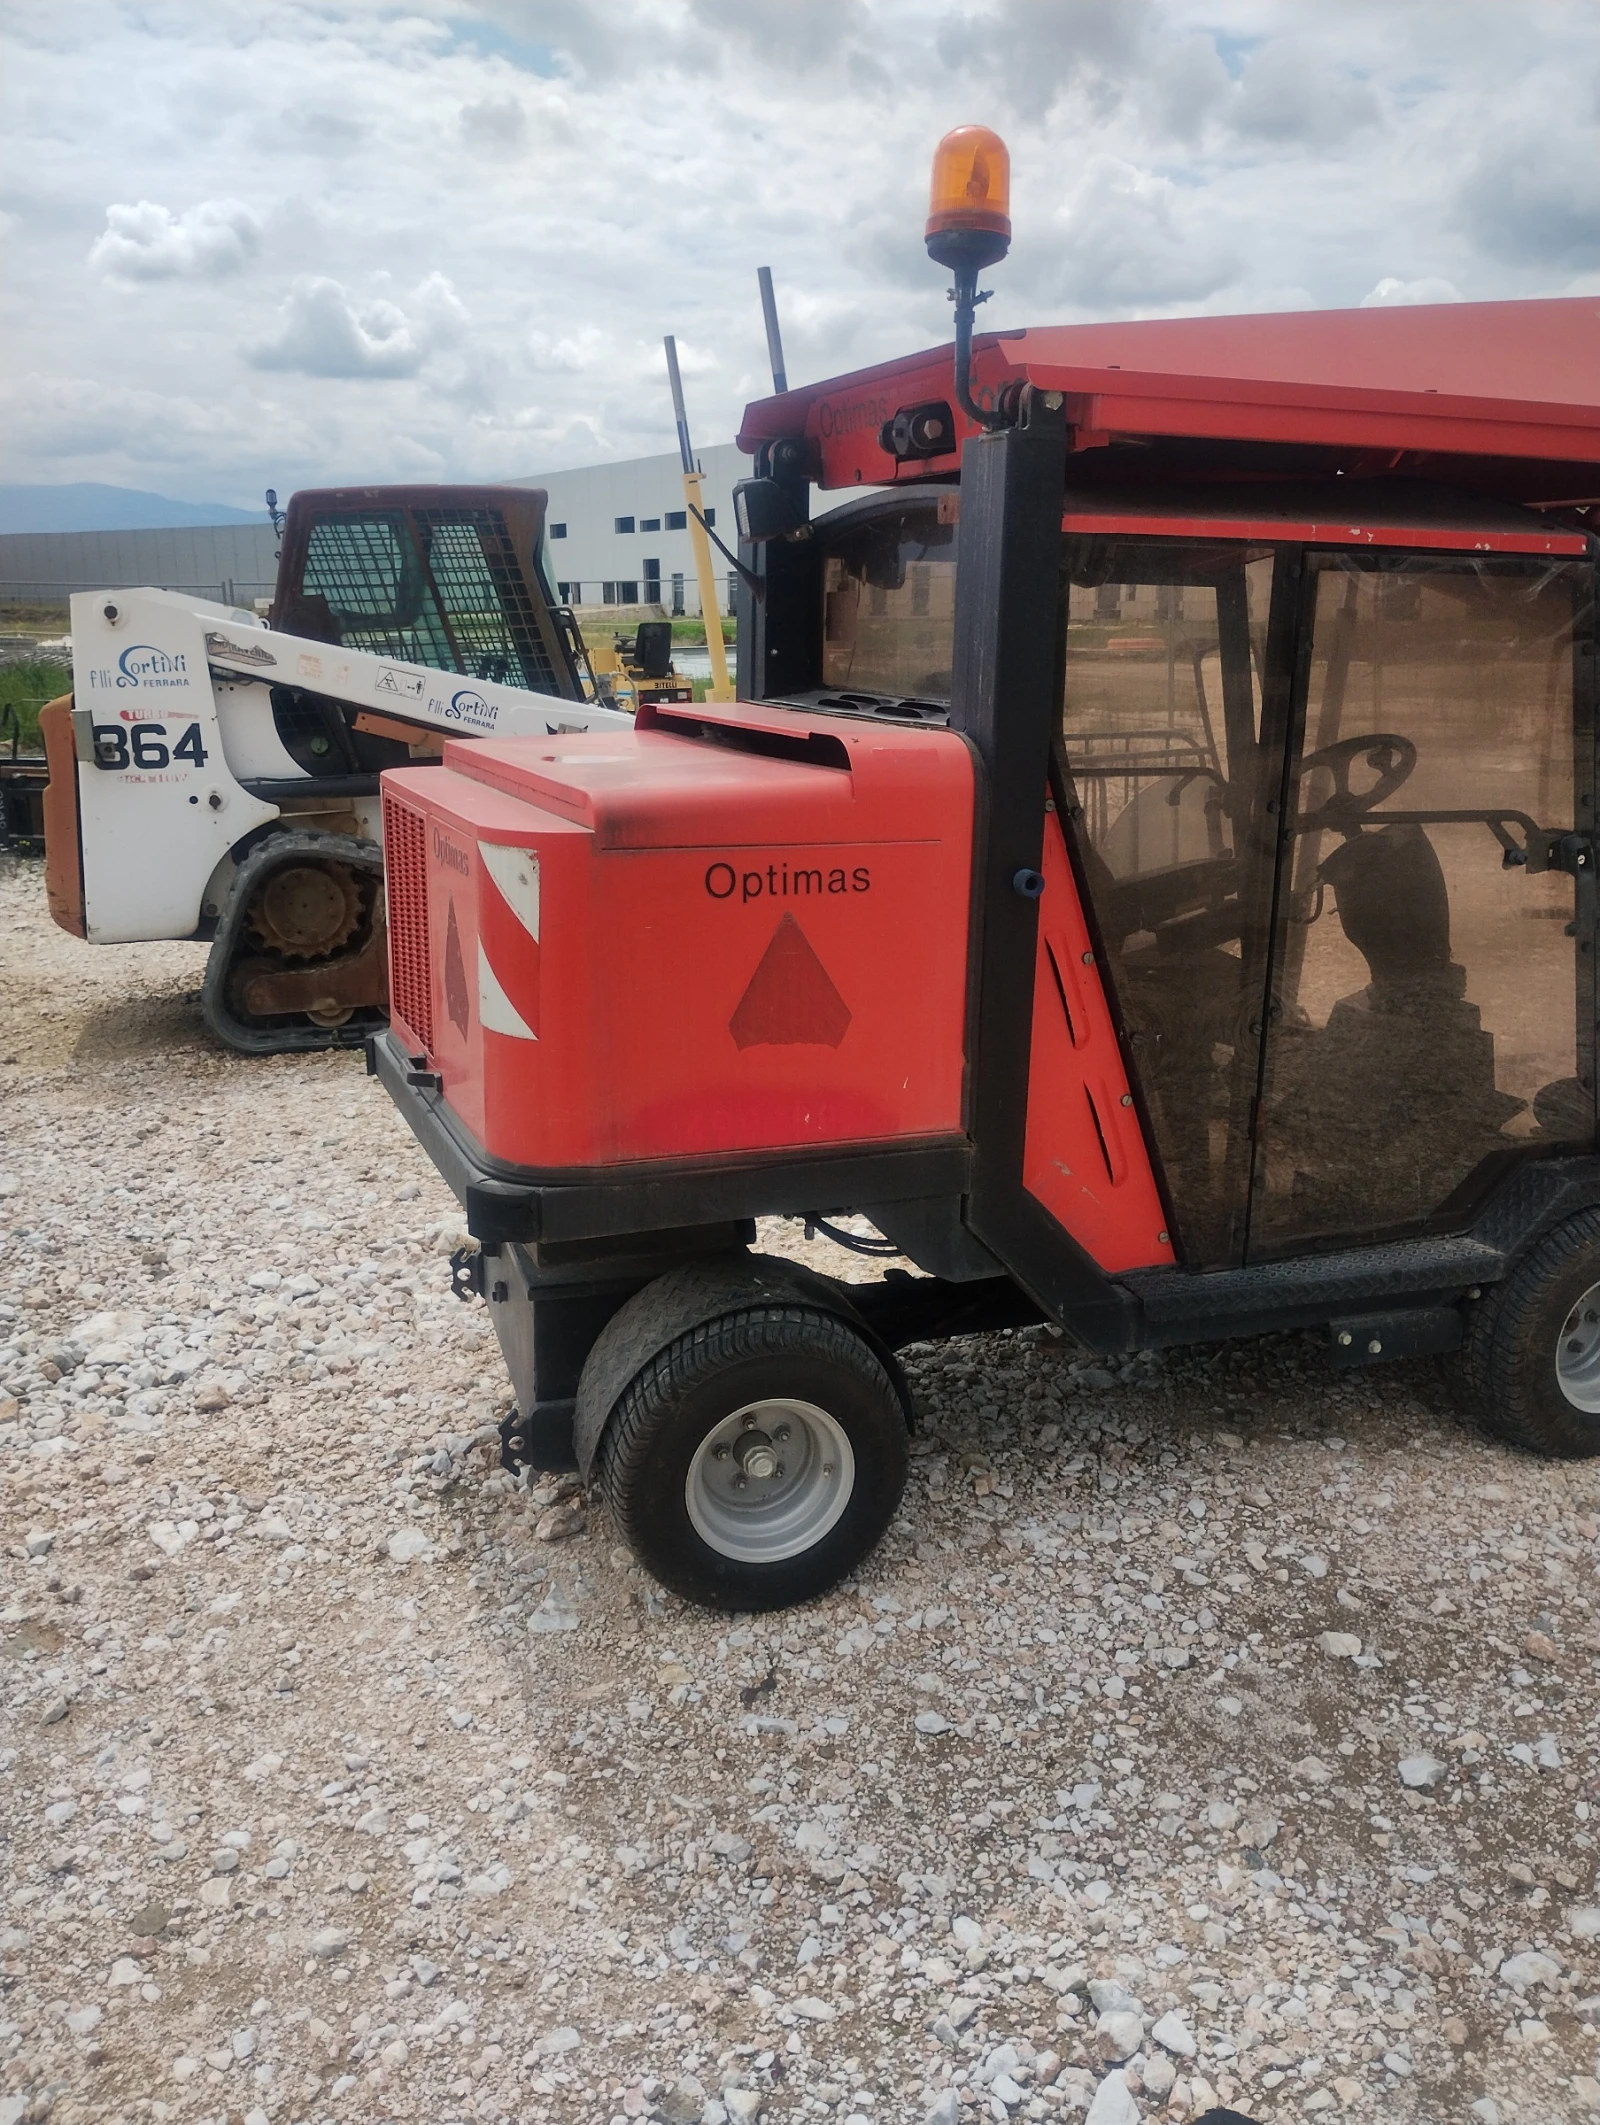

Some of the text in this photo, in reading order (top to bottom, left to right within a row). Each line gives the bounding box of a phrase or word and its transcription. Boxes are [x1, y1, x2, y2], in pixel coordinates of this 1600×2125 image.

[820, 395, 888, 442] Optimas
[143, 678, 190, 688] FERRARA
[127, 709, 169, 720] TURBO
[463, 716, 495, 730] FERRARA
[93, 723, 208, 770] 864
[433, 826, 470, 878] Optimas
[705, 862, 871, 904] Optimas
